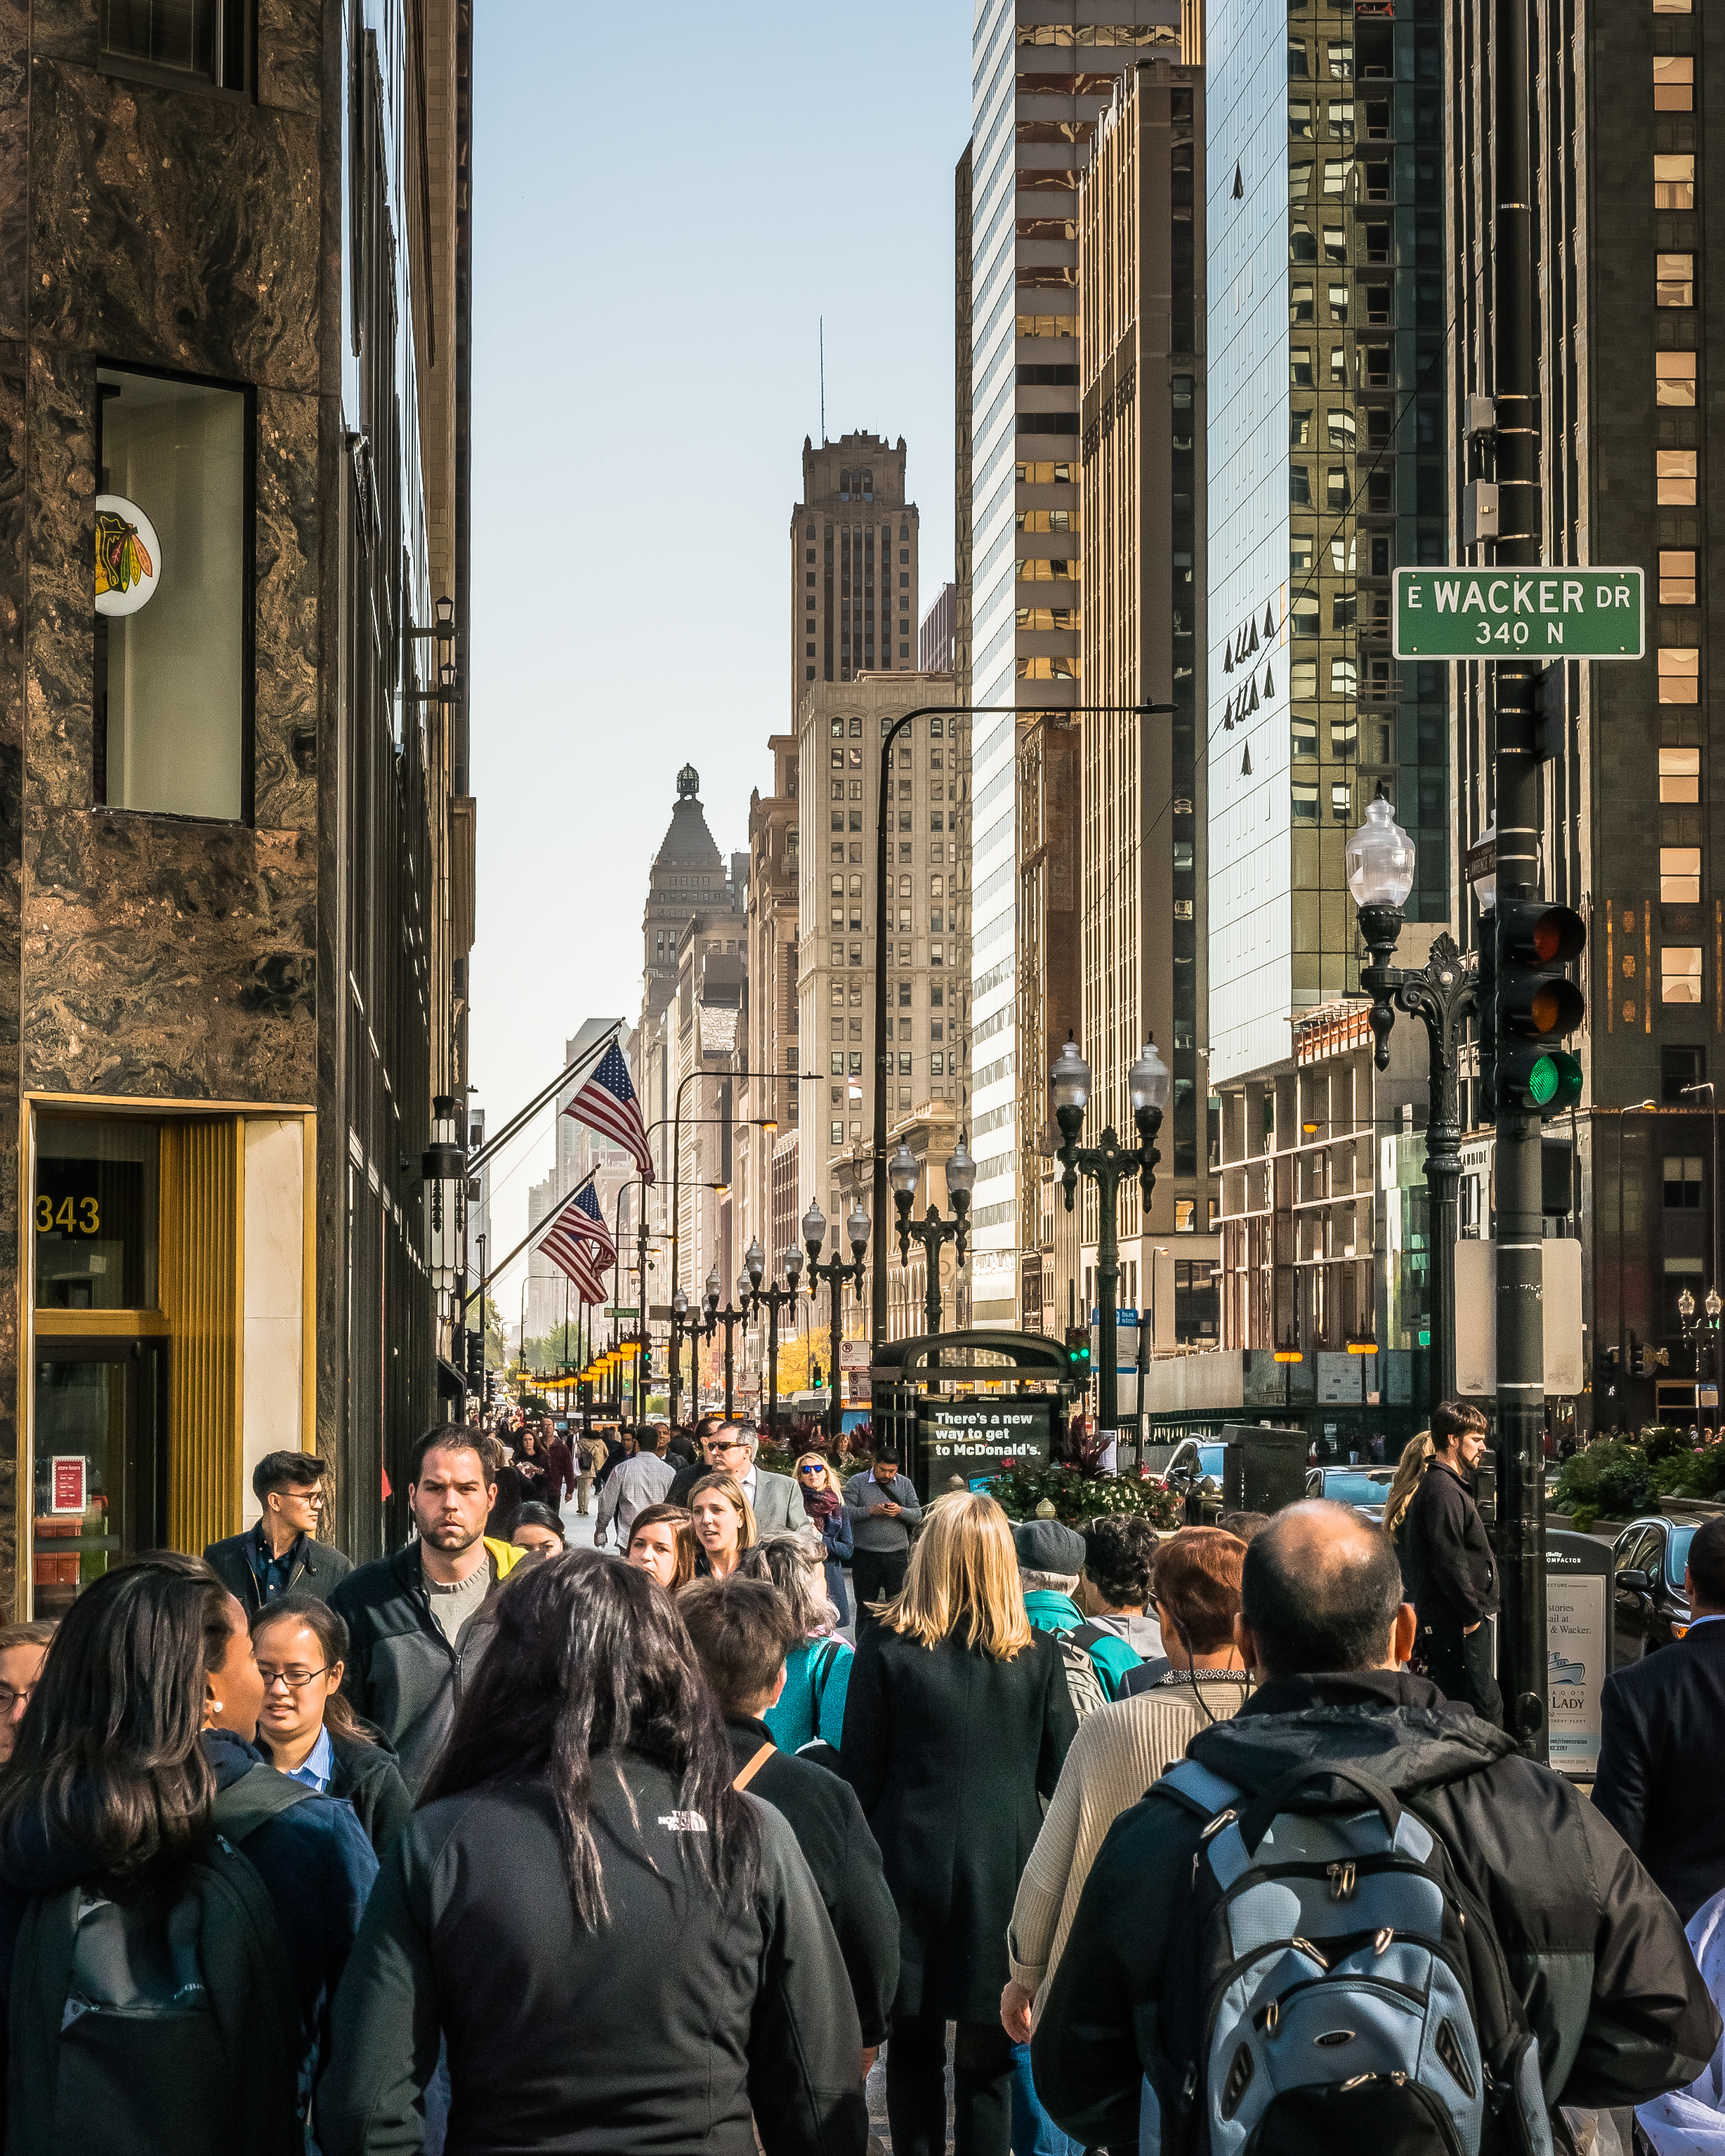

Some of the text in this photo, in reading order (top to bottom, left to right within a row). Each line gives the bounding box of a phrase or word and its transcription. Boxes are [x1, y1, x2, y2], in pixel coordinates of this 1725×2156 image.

[1408, 580, 1631, 613] E WACKER DR
[1476, 622, 1563, 645] 340 N
[36, 1195, 100, 1233] 343
[1122, 1317, 1136, 1326] stop
[936, 1412, 1033, 1424] There's a new
[936, 1428, 1010, 1442] way to get
[936, 1443, 1042, 1456] to McDonald's.
[1548, 1603, 1574, 1612] stories
[1550, 1625, 1591, 1634] & Wacker.
[1552, 1696, 1585, 1709] LADY
